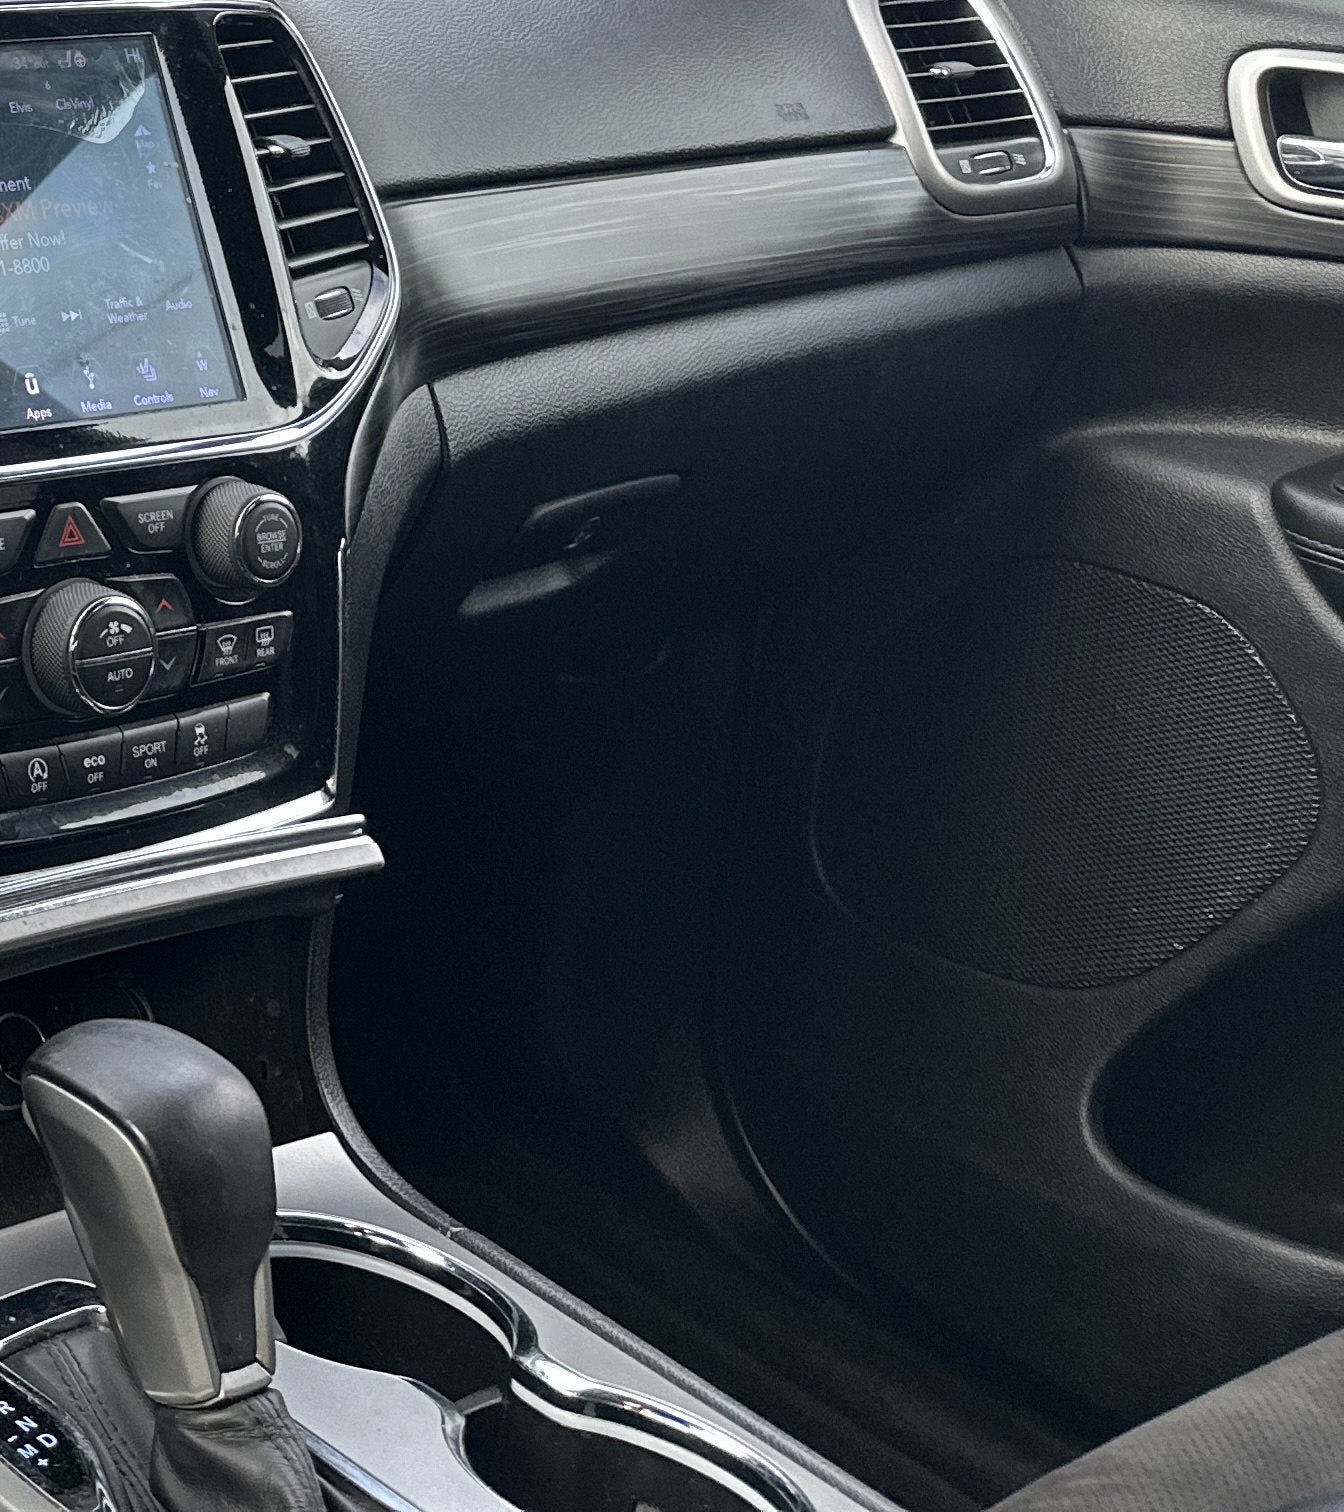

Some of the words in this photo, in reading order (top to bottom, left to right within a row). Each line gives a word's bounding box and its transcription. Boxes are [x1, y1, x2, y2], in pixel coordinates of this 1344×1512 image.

[8, 101, 34, 114] Elvis
[27, 229, 66, 249] Now!
[103, 296, 133, 310] Traffic
[165, 299, 193, 311] Audio
[12, 315, 37, 328] Tune
[106, 310, 148, 324] Weather
[133, 391, 175, 406] Controls
[199, 387, 219, 399] Nav
[80, 399, 113, 413] Media
[26, 406, 53, 421] Apps
[137, 509, 174, 524] SCREEN
[147, 522, 166, 535] OFF
[256, 529, 287, 540] BROWSE
[260, 541, 284, 553] ENTER
[106, 635, 125, 647] OFF
[256, 645, 276, 657] REAR
[215, 655, 239, 667] FRONT
[106, 667, 134, 682] AUTO
[131, 740, 167, 758] SPORT
[193, 745, 209, 757] OFF
[83, 753, 106, 768] eco
[144, 757, 158, 769] ON
[87, 771, 105, 785] OFF
[30, 780, 48, 793] OFF
[14, 1416, 38, 1432] N
[36, 1433, 58, 1448] D
[17, 1444, 39, 1459] M
